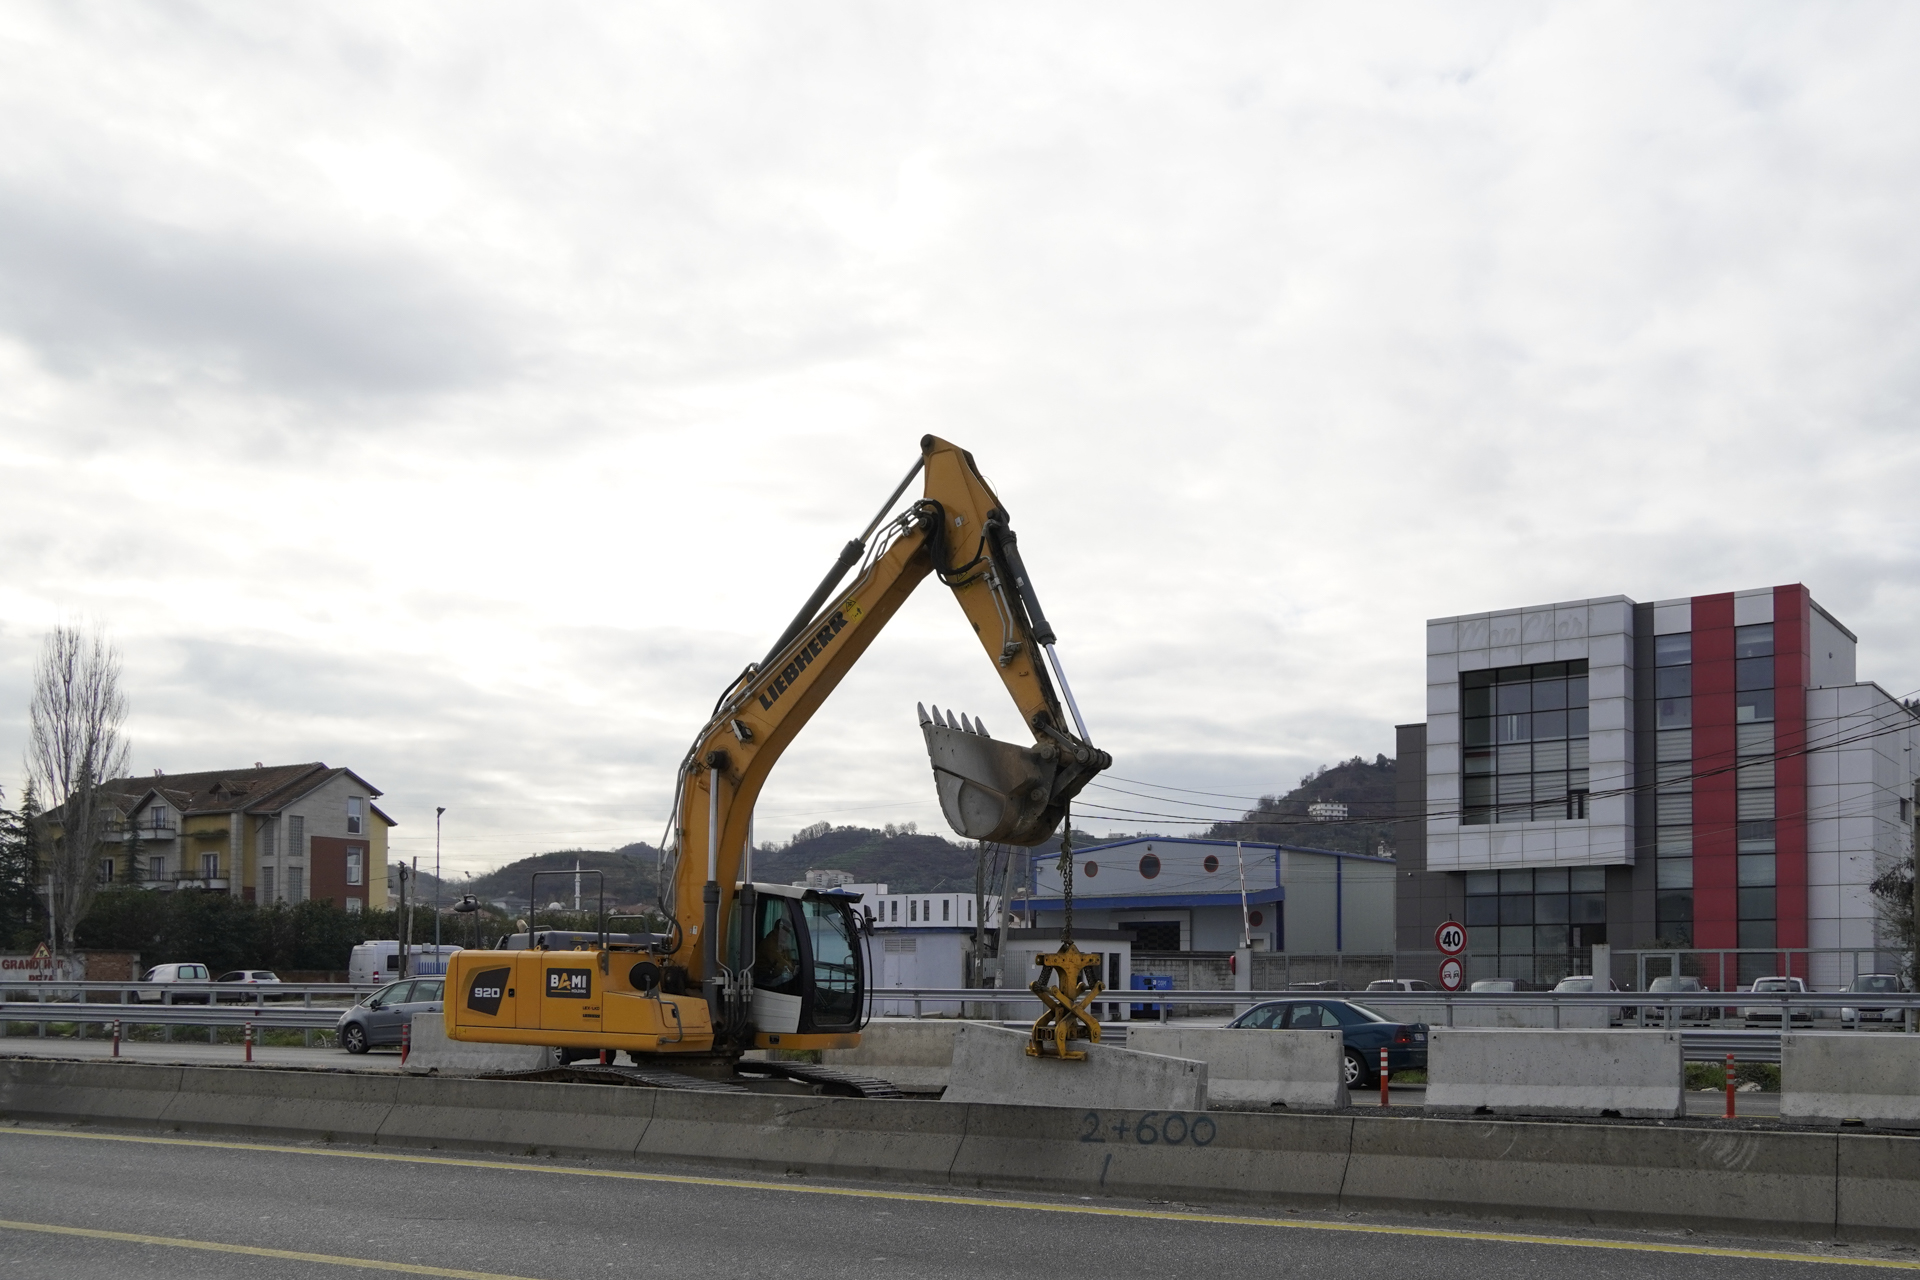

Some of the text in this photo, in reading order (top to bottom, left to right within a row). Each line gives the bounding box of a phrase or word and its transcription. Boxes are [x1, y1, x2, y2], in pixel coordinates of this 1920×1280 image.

[758, 610, 849, 712] LIEBHERR
[1442, 930, 1461, 948] 40
[1, 959, 40, 970] GRAND
[550, 972, 587, 990] BAMI
[474, 987, 500, 998] 920
[1081, 1111, 1217, 1147] 2+600
